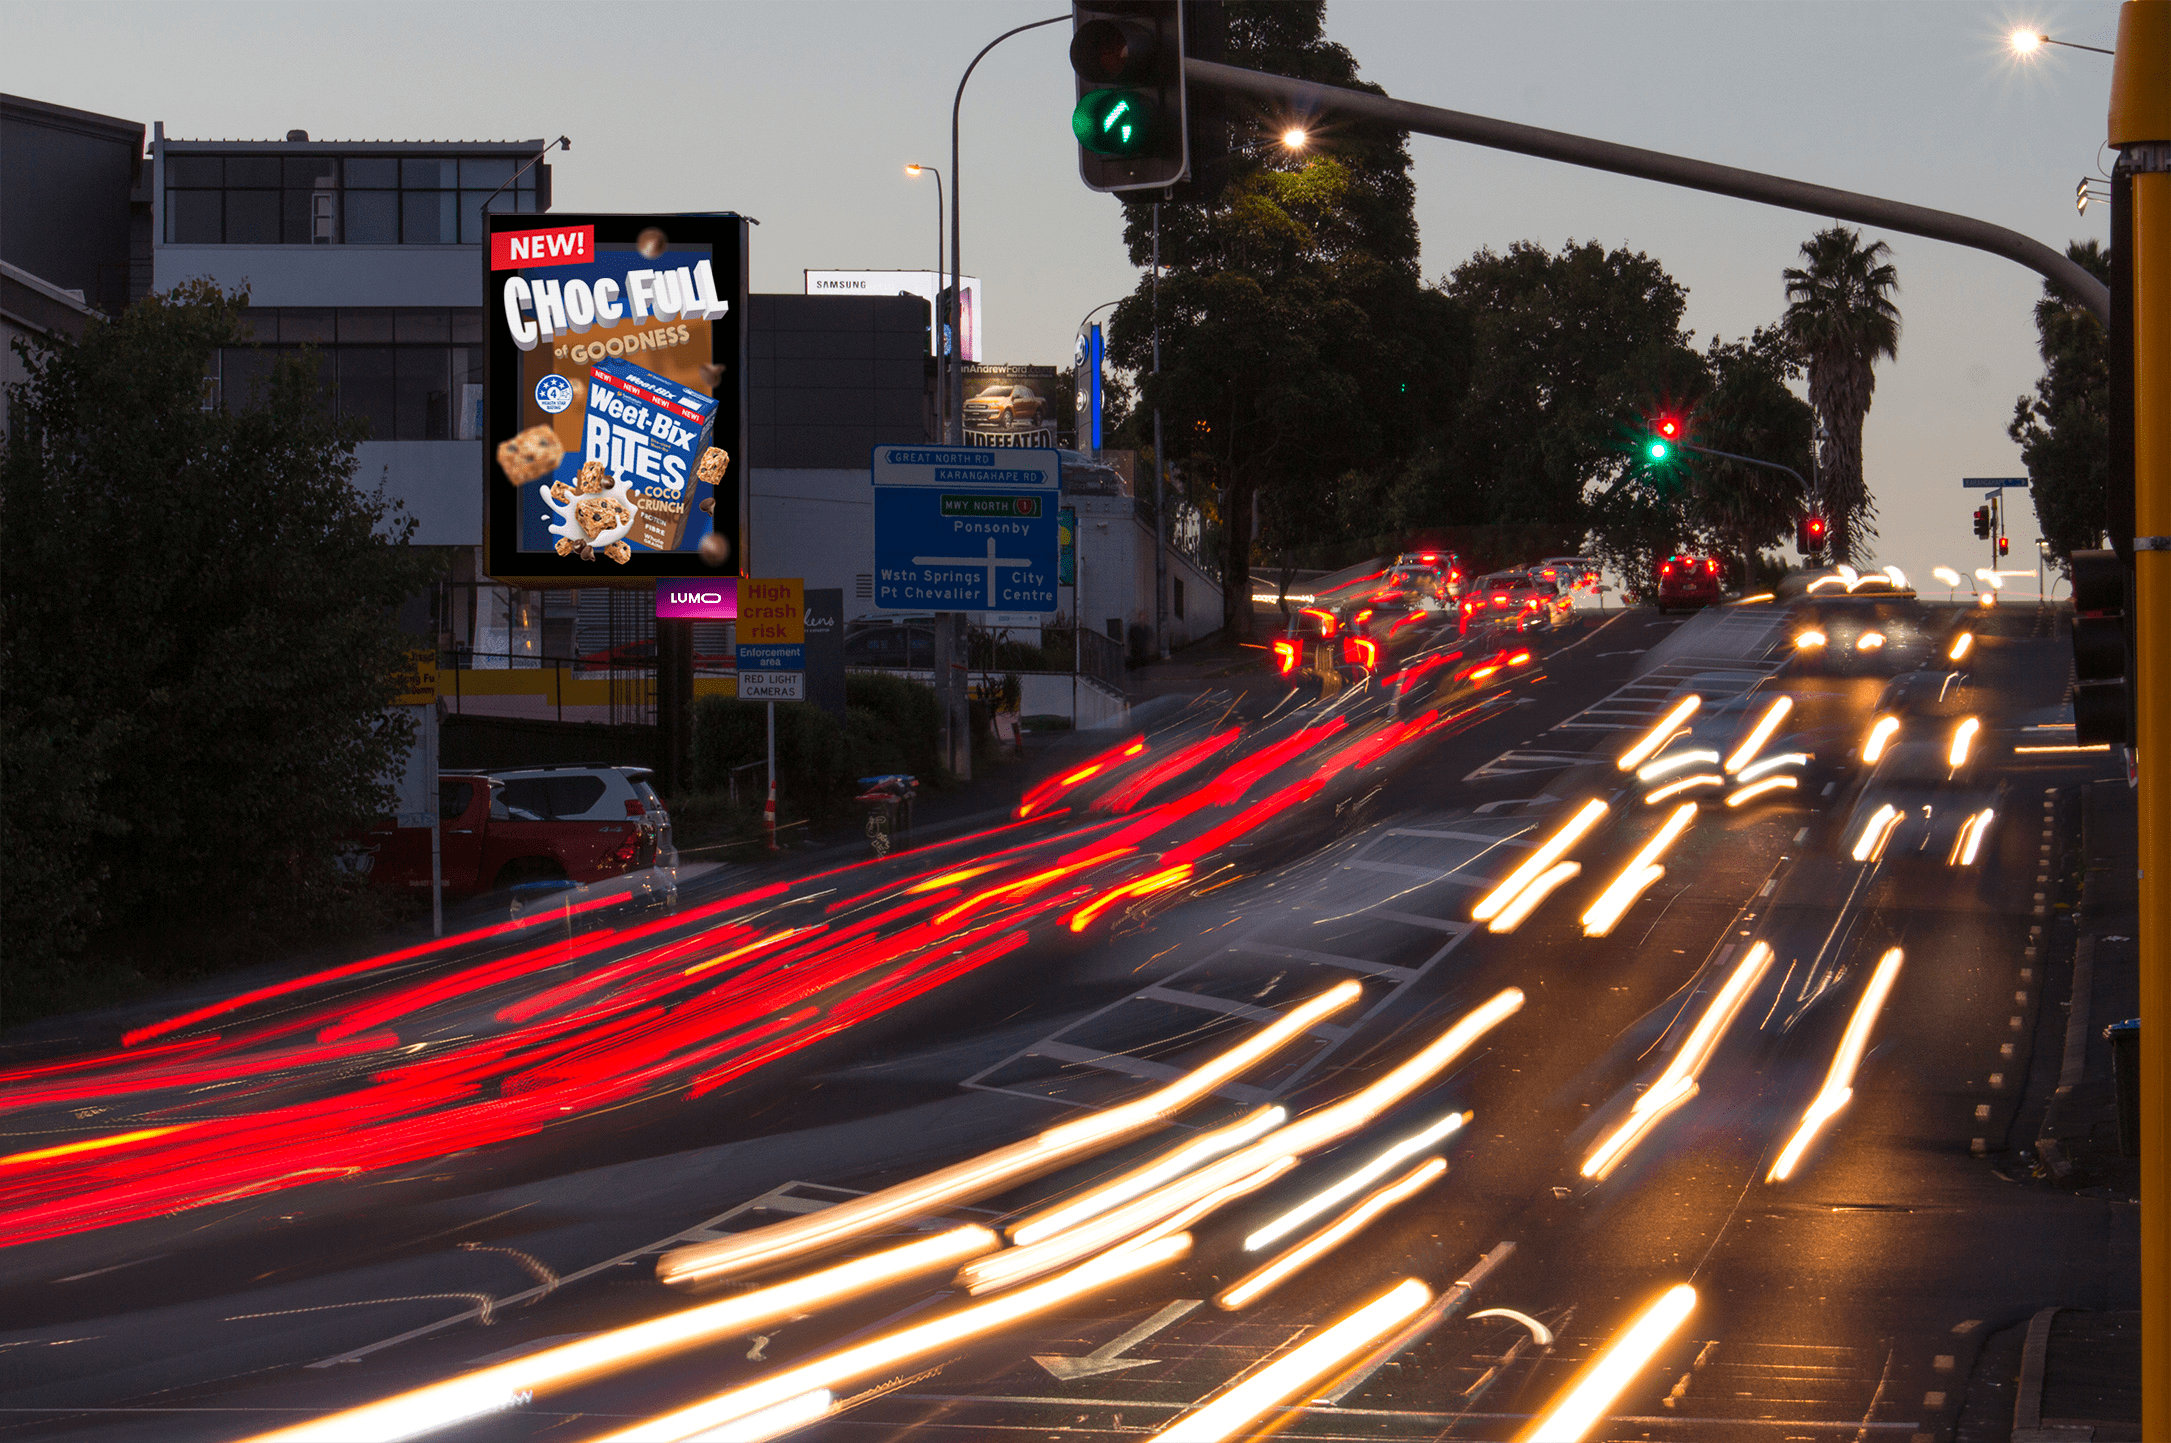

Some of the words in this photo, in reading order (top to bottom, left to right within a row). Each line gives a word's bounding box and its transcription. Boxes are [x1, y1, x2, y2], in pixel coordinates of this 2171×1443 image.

[510, 231, 585, 261] NEW!
[816, 280, 867, 289] SAMSUNG
[504, 276, 624, 351] CHOC
[625, 259, 729, 326] FULL
[571, 325, 690, 365] GOODNESS
[594, 370, 611, 383] NEW!
[623, 383, 640, 395] NEW!
[625, 375, 677, 399] Weet-Bix
[550, 389, 557, 399] 4
[652, 396, 670, 408] NEW!
[589, 383, 698, 452] Weet-Bix
[681, 409, 700, 422] NEW!
[895, 452, 931, 462] GREAT
[935, 453, 971, 463] NORTH
[974, 454, 989, 463] RD
[939, 470, 1018, 481] KARANGAHAPE
[1023, 472, 1037, 482] RD
[644, 485, 681, 500] COCO
[637, 498, 685, 514] CRUNCH
[945, 501, 969, 509] MWY
[973, 501, 1009, 511] NORTH
[640, 512, 667, 527] PROTEIN
[644, 523, 666, 537] FIBRE
[954, 520, 1030, 536] Ponsonby
[881, 569, 917, 581] Wstn
[923, 569, 981, 586] Springs
[1011, 571, 1044, 586] City
[670, 592, 721, 604] LUMO
[748, 584, 791, 602] High
[881, 586, 898, 598] Pt
[904, 586, 981, 599] Chevalier
[1003, 588, 1053, 601] Centre
[743, 604, 797, 618] crash
[751, 623, 787, 638] risk
[739, 647, 801, 657] Enforcement
[759, 657, 782, 666] area
[423, 673, 435, 682] Fu
[744, 675, 764, 684] RED
[769, 675, 797, 685] LIGHT
[746, 687, 796, 696] CAMERAS
